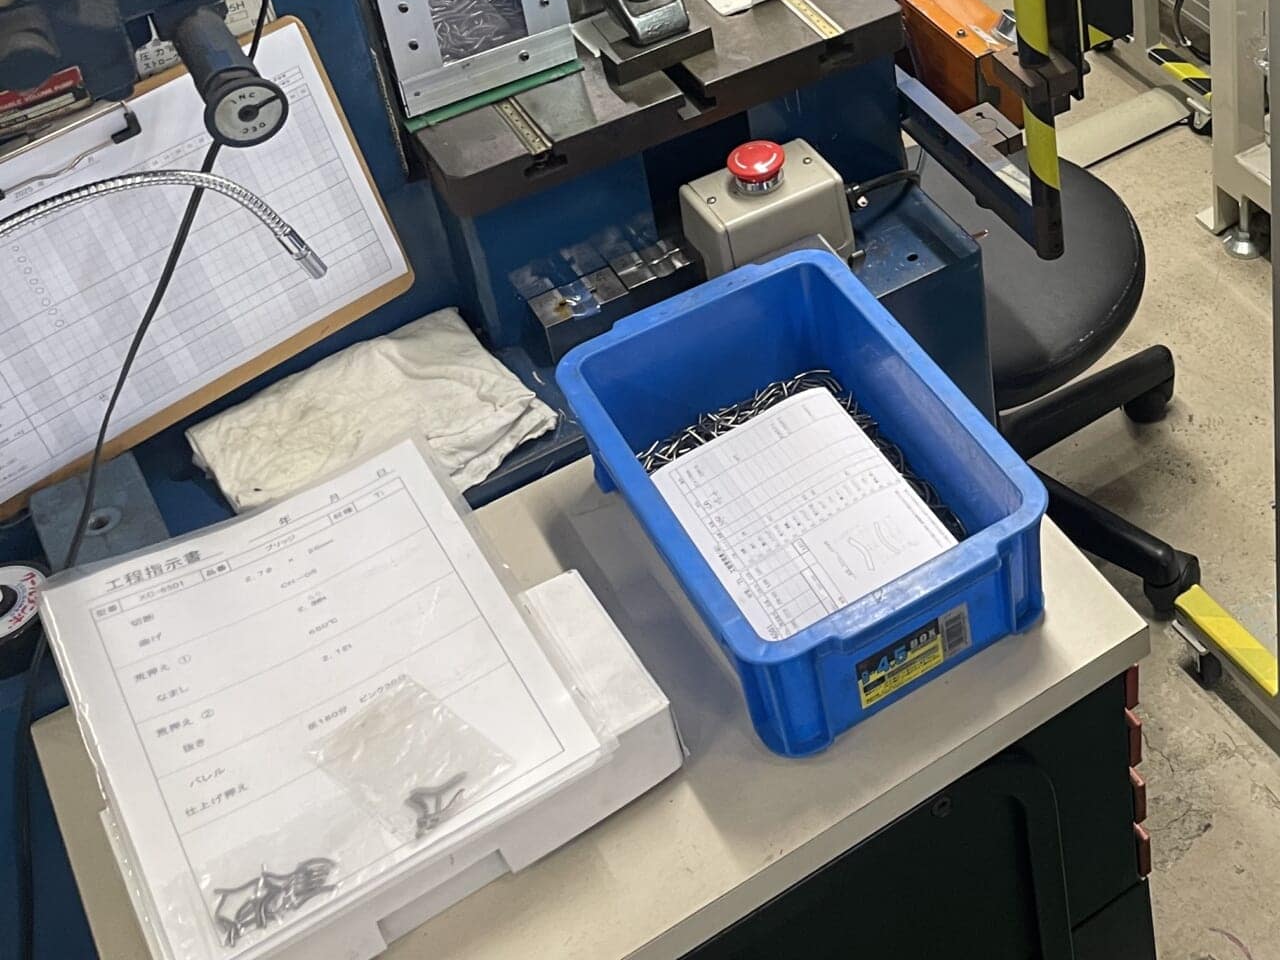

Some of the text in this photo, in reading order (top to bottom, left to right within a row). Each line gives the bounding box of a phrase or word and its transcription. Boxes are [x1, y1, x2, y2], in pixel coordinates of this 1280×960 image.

[229, 91, 256, 105] INC
[240, 121, 267, 135] DEC
[279, 468, 387, 526] 年 月 日
[106, 550, 202, 590] 工程指示書
